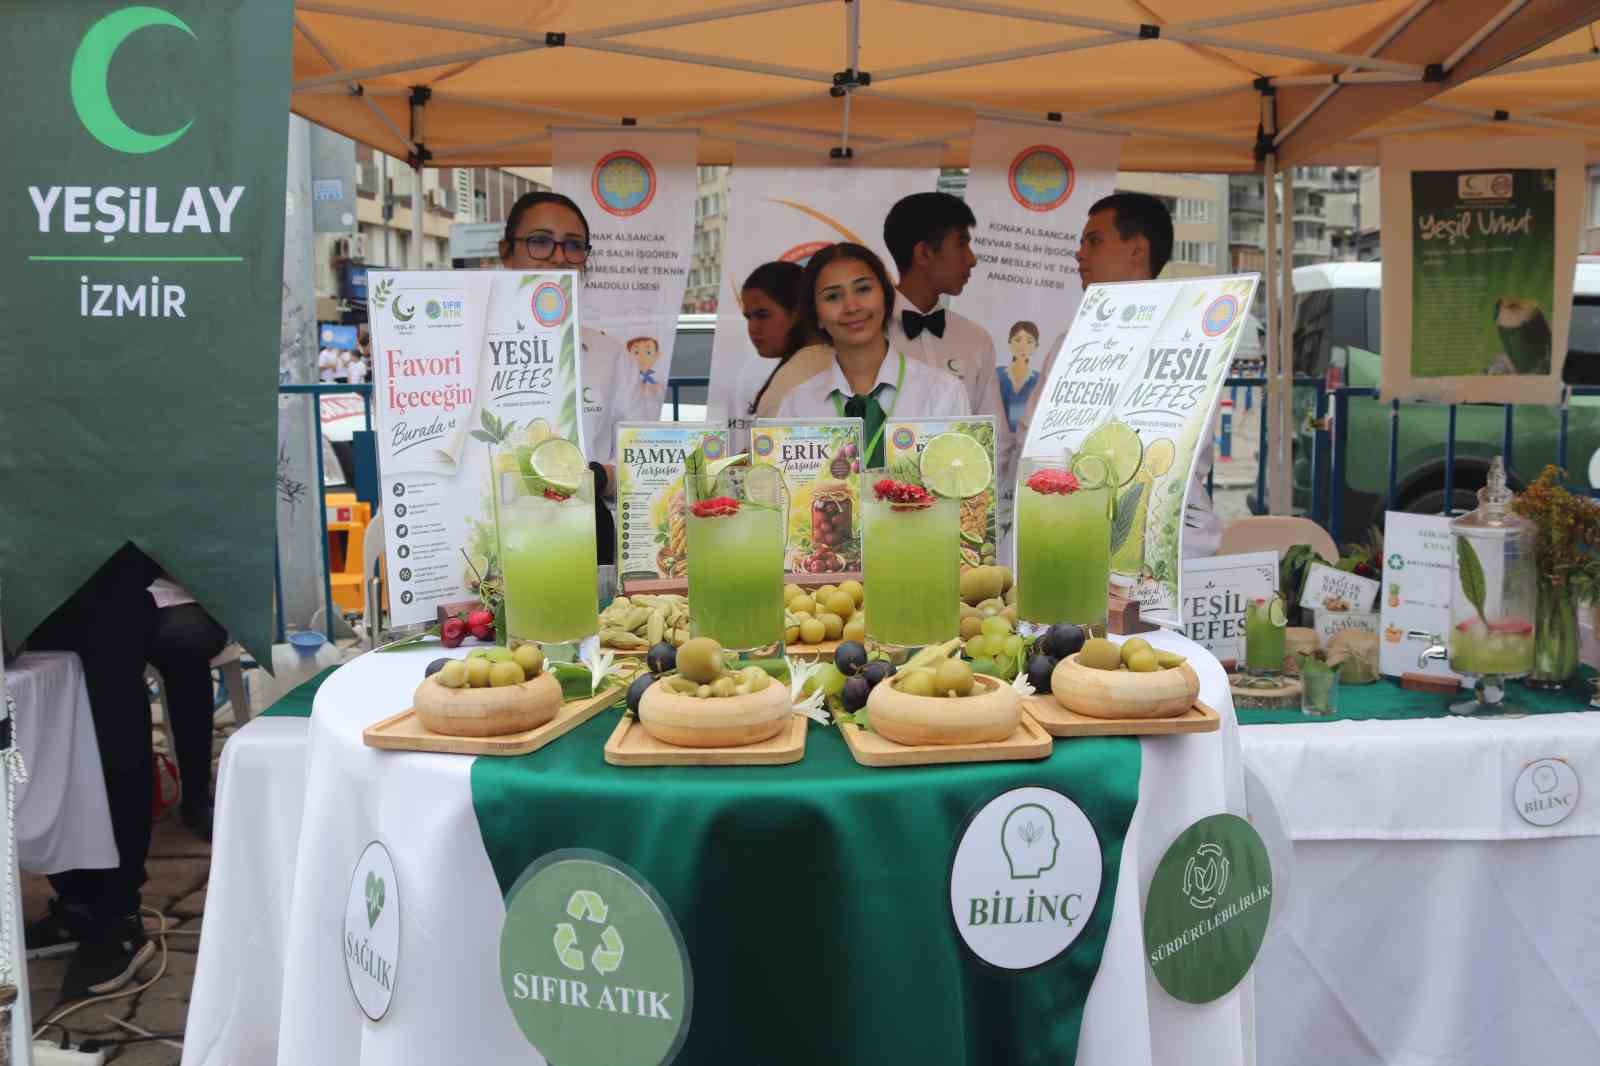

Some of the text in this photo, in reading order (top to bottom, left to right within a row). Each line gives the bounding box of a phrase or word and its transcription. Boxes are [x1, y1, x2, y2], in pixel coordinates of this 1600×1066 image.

[615, 232, 666, 242] ALSANCAK
[988, 223, 1077, 240] KONAK ALSANCAK
[584, 281, 629, 290] ANADOLU
[987, 272, 1033, 285] ANADOLU
[81, 275, 186, 318] İZMİR
[386, 350, 463, 377] Favori
[488, 336, 553, 368] YEŞİL
[1065, 341, 1133, 377] Favori
[1143, 343, 1212, 384] YEŞİL
[490, 368, 553, 392] NEFES
[1050, 375, 1120, 407] İÇECEĞİN
[388, 380, 472, 415] İçeceğin
[1124, 383, 1207, 410] NEFES
[391, 416, 447, 447] Burada
[624, 448, 687, 464] BAMYA
[782, 442, 830, 460] ERİK
[1184, 590, 1248, 620] EŞİL
[967, 889, 1083, 927] BİLİNÇ
[1151, 883, 1272, 966] SÜRDÜRÜLEBİLİRLİK
[344, 931, 391, 990] SAĞLIK
[512, 972, 673, 1021] SIFIR ATIK
